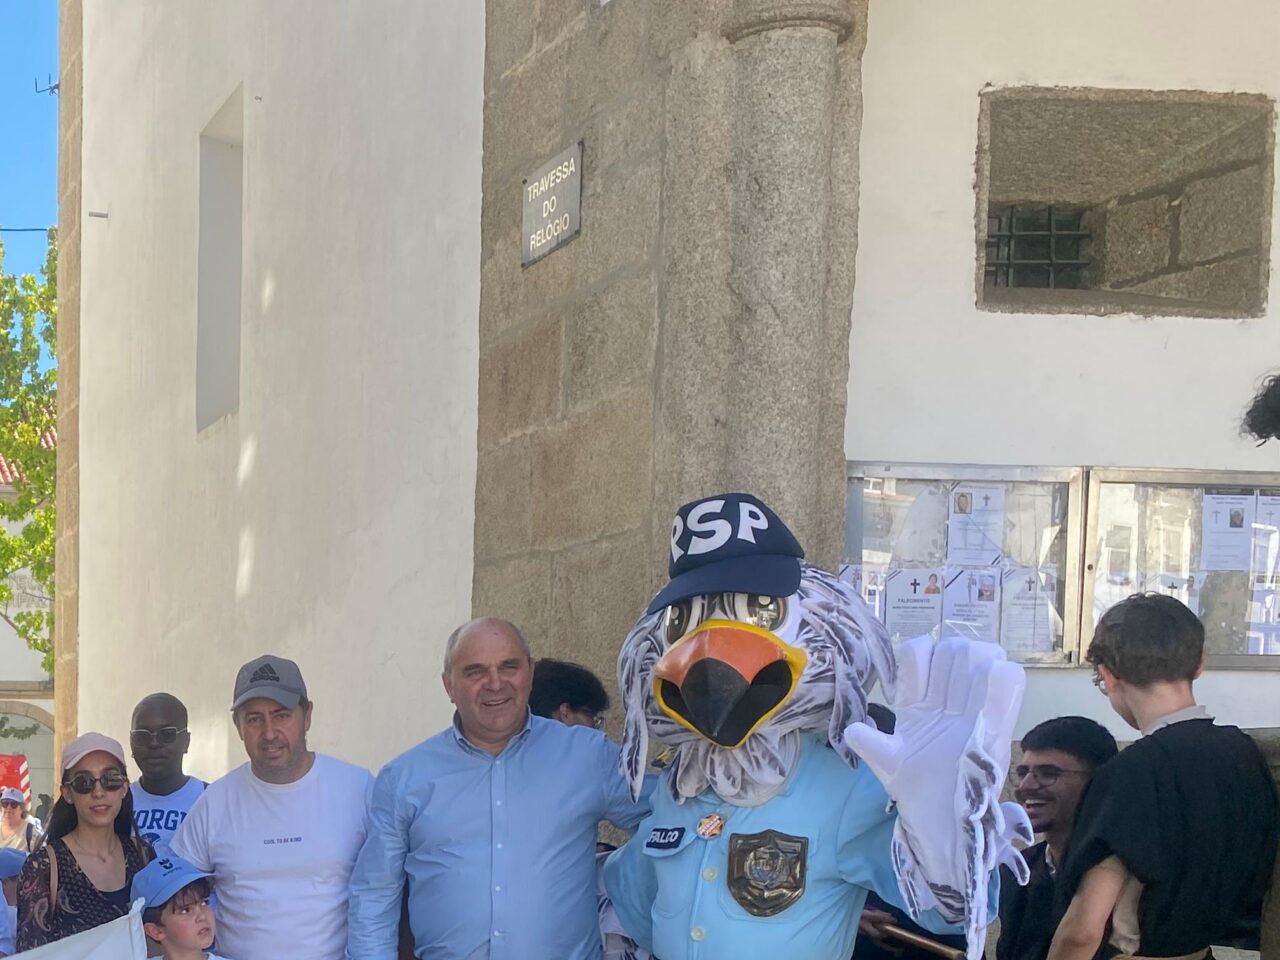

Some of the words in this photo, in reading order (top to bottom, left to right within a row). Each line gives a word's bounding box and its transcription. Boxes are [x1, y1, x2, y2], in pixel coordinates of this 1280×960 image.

[527, 157, 576, 202] TRAVESSA
[542, 195, 557, 218] DO
[529, 213, 570, 252] RELÓGIO
[649, 830, 679, 844] FALCO
